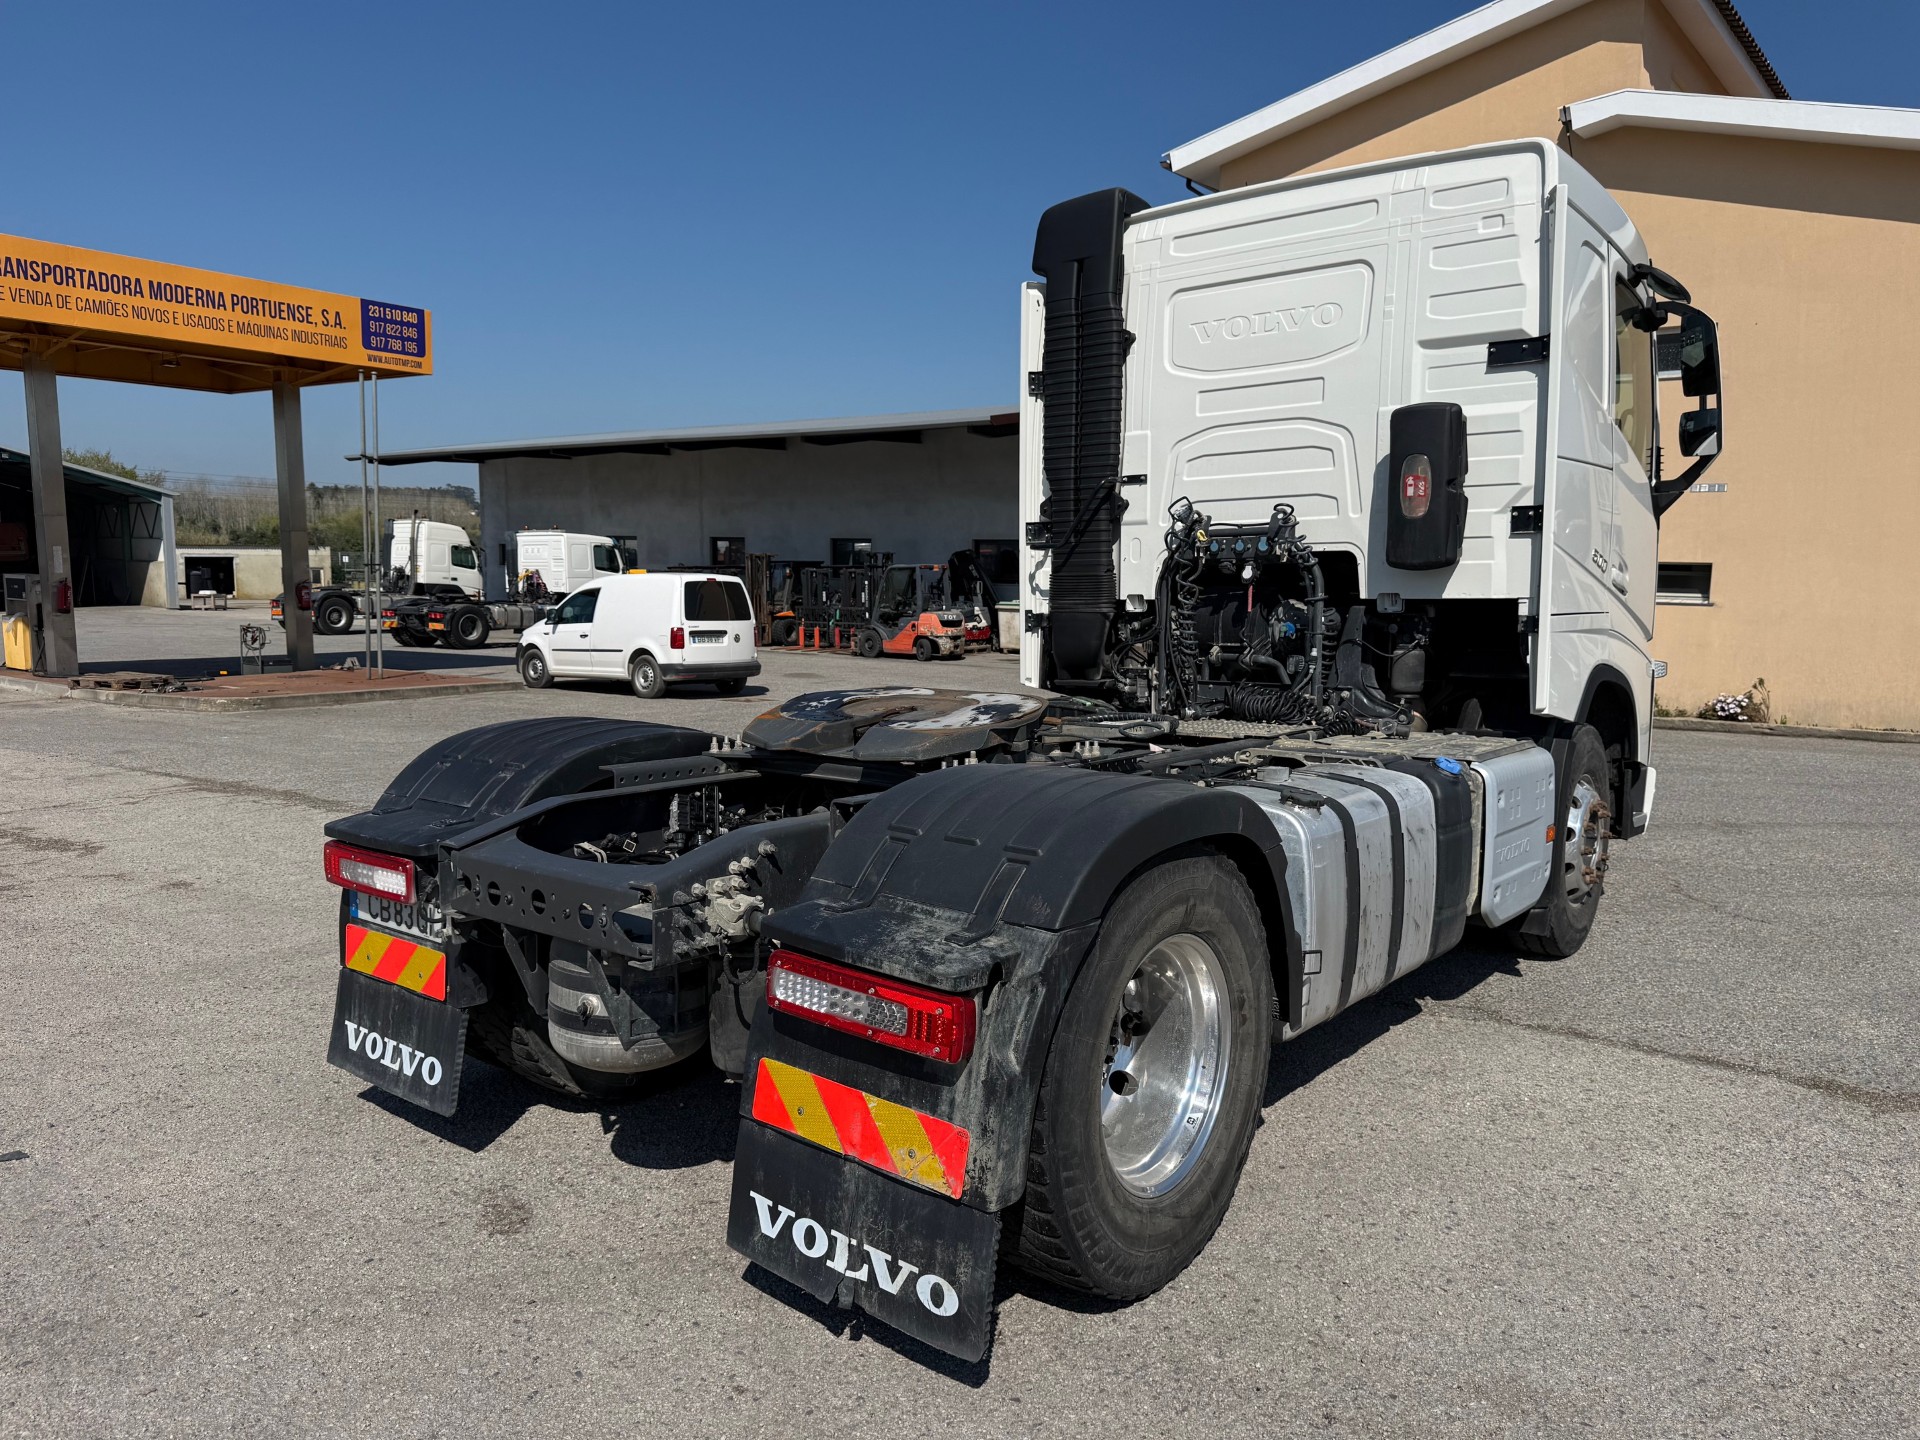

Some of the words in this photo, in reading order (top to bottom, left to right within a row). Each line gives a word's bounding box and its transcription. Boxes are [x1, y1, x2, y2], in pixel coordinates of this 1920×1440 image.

[9, 286, 53, 308] VENDA
[56, 293, 72, 310] DE
[75, 296, 129, 318] CAMIÕES
[132, 305, 170, 324] NOVOS
[173, 311, 179, 325] E
[182, 312, 225, 332] USADOS
[228, 319, 234, 333] E
[236, 320, 289, 341] MÁQUINAS
[291, 329, 348, 350] INDUSTRIAIS
[149, 280, 227, 311] MODERNA
[231, 293, 318, 327] PORTUENSE,
[321, 308, 347, 330] S.A.
[368, 305, 384, 319] 231
[386, 307, 401, 321] 510
[402, 310, 418, 324] 840
[369, 320, 384, 334] 917
[386, 323, 401, 336] 822
[402, 326, 418, 339] 846
[1189, 302, 1343, 344] VOLVO
[367, 353, 423, 369] WWW.AUTOTMP.COM
[370, 336, 385, 349] 917
[387, 338, 402, 351] 768
[404, 341, 418, 354] 195
[1495, 837, 1530, 865] VOLVO
[345, 1019, 443, 1086] VOLVO
[750, 1190, 959, 1317] VOLVO
